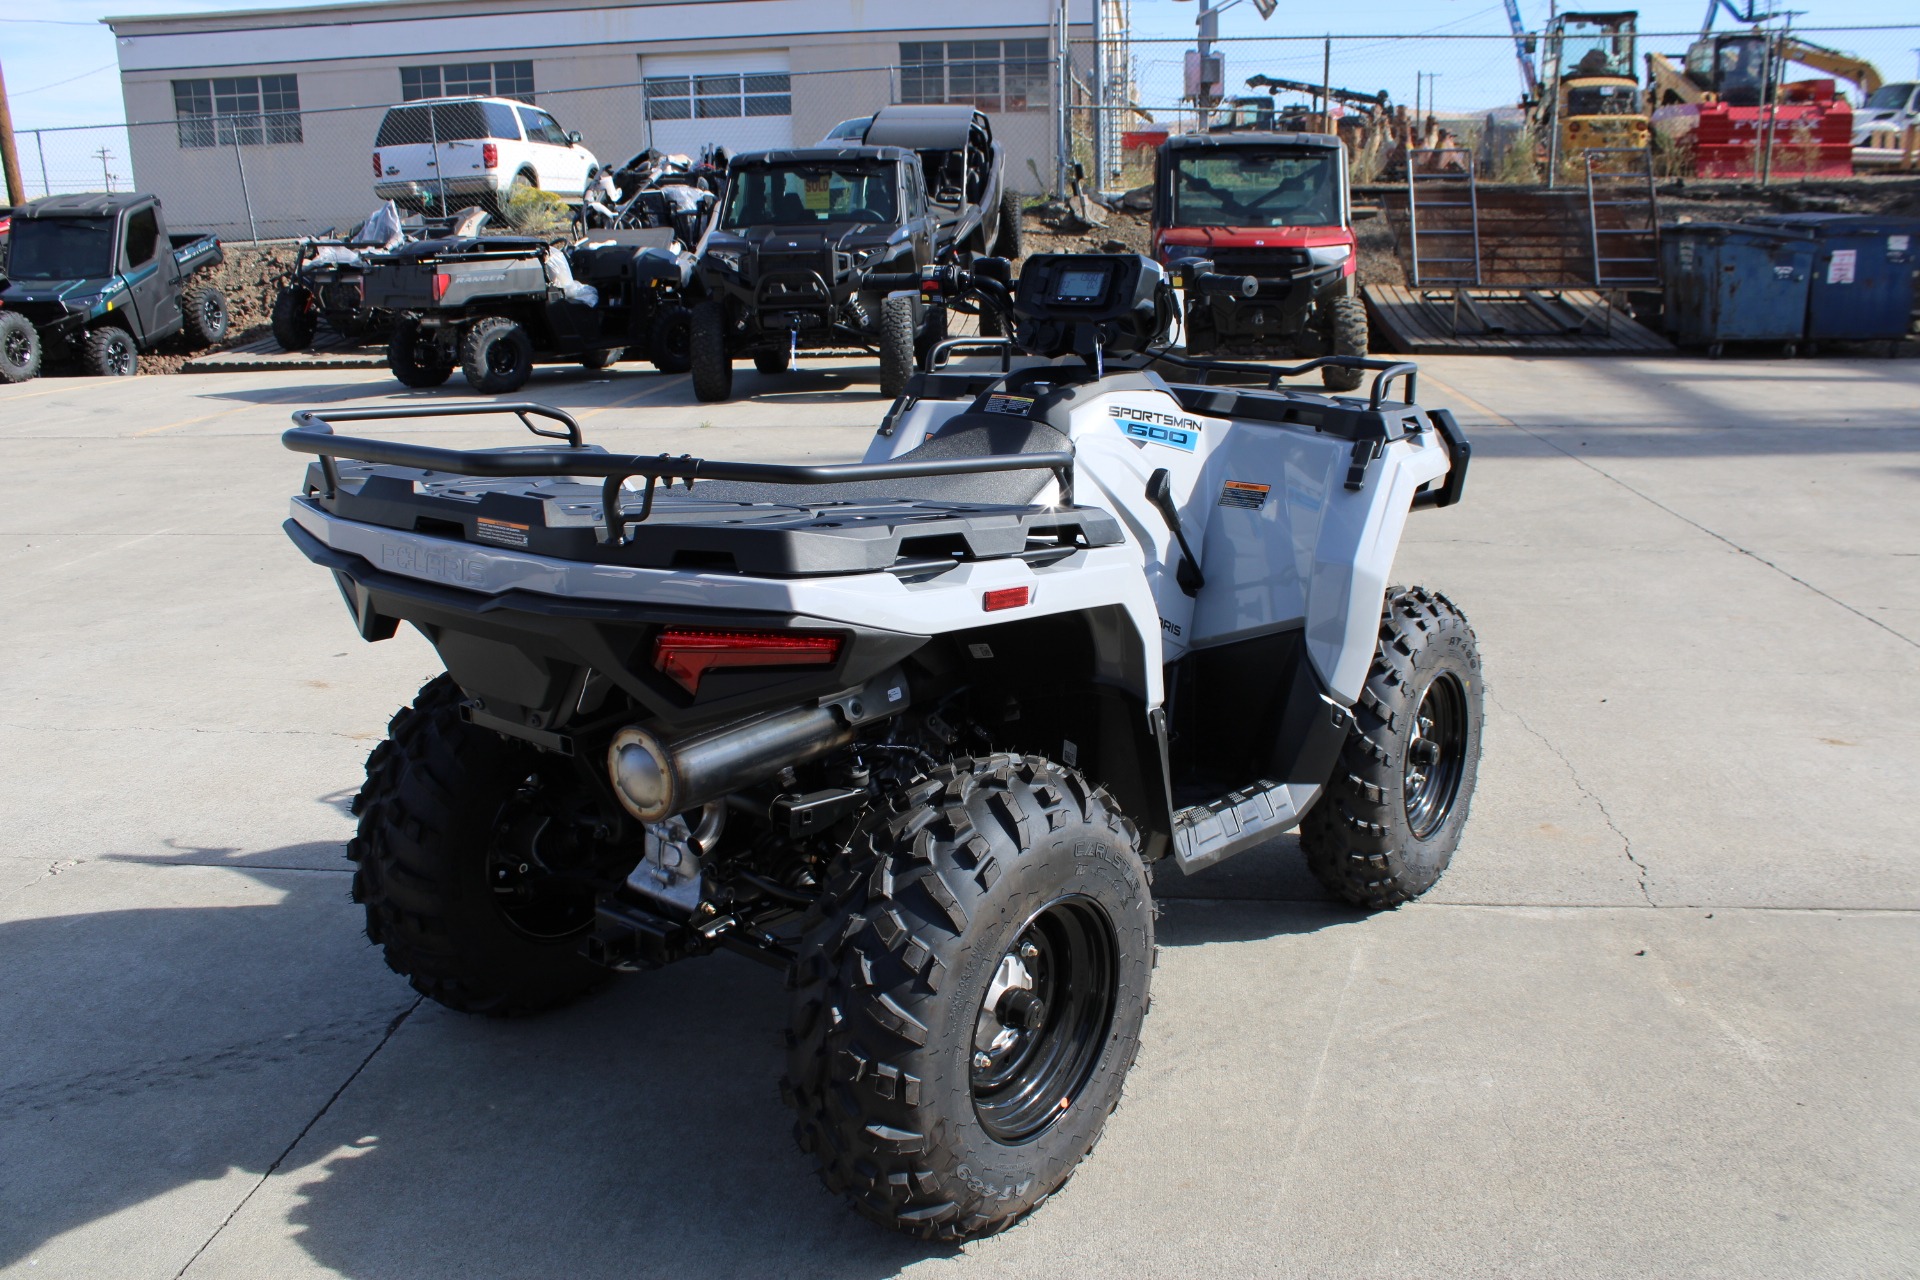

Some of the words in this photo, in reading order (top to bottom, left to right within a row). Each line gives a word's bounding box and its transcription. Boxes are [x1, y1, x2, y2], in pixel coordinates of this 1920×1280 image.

[805, 180, 828, 193] SOLD
[455, 274, 506, 284] RANGER
[1108, 405, 1203, 432] SPORTSMAN
[1127, 423, 1188, 445] 600
[381, 543, 486, 584] POLARIS
